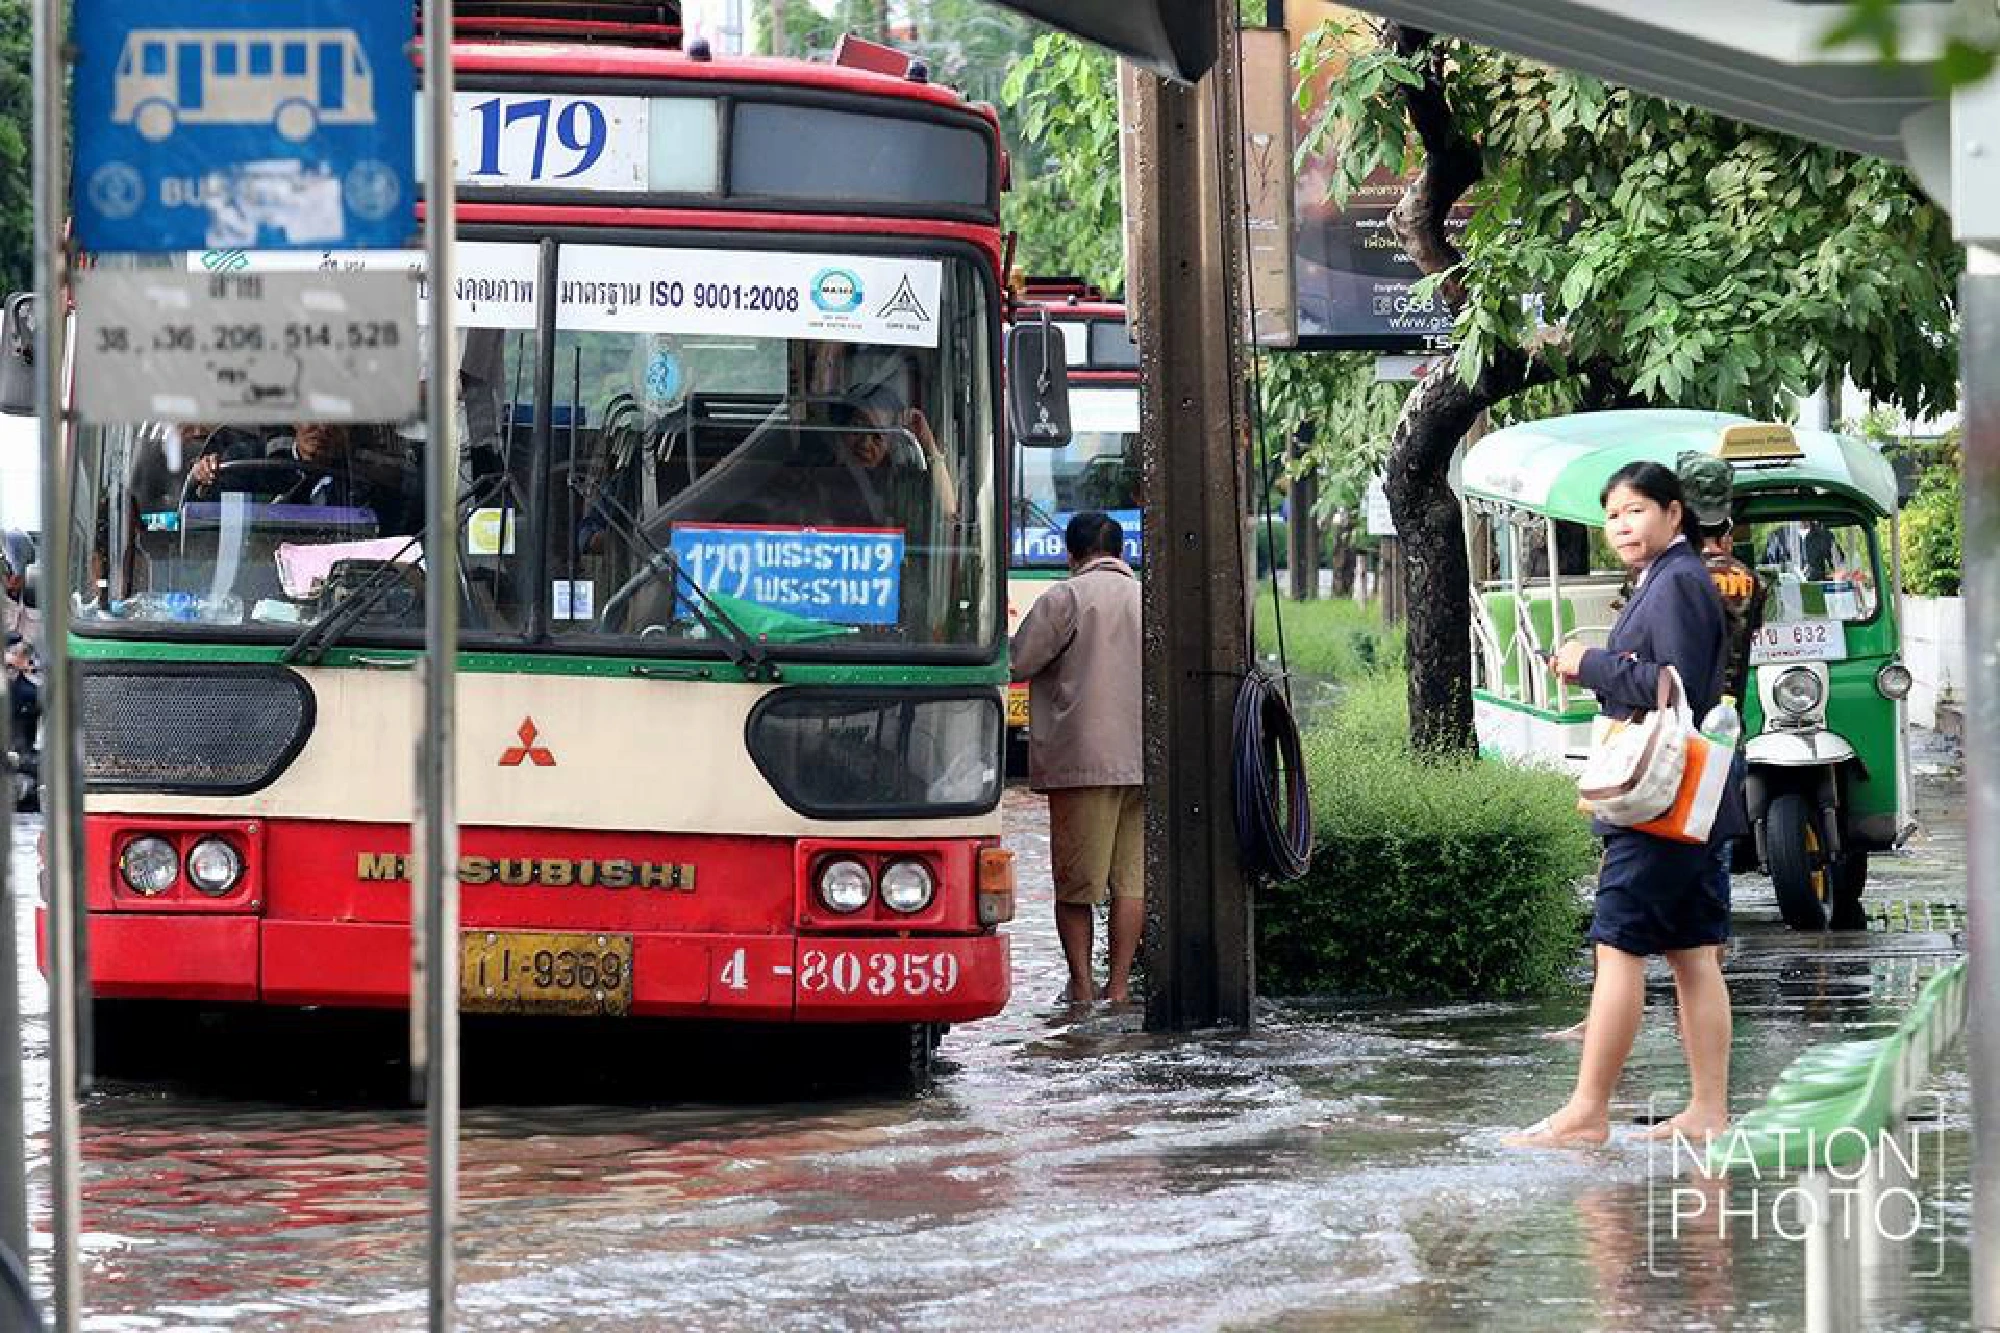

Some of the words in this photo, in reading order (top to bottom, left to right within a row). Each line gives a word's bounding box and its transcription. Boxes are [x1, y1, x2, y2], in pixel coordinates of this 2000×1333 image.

[470, 97, 607, 181] 179
[649, 280, 684, 308] ISO
[693, 282, 800, 313] 9001:2008
[1793, 624, 1826, 645] 632
[357, 852, 696, 891] MISUBISHI
